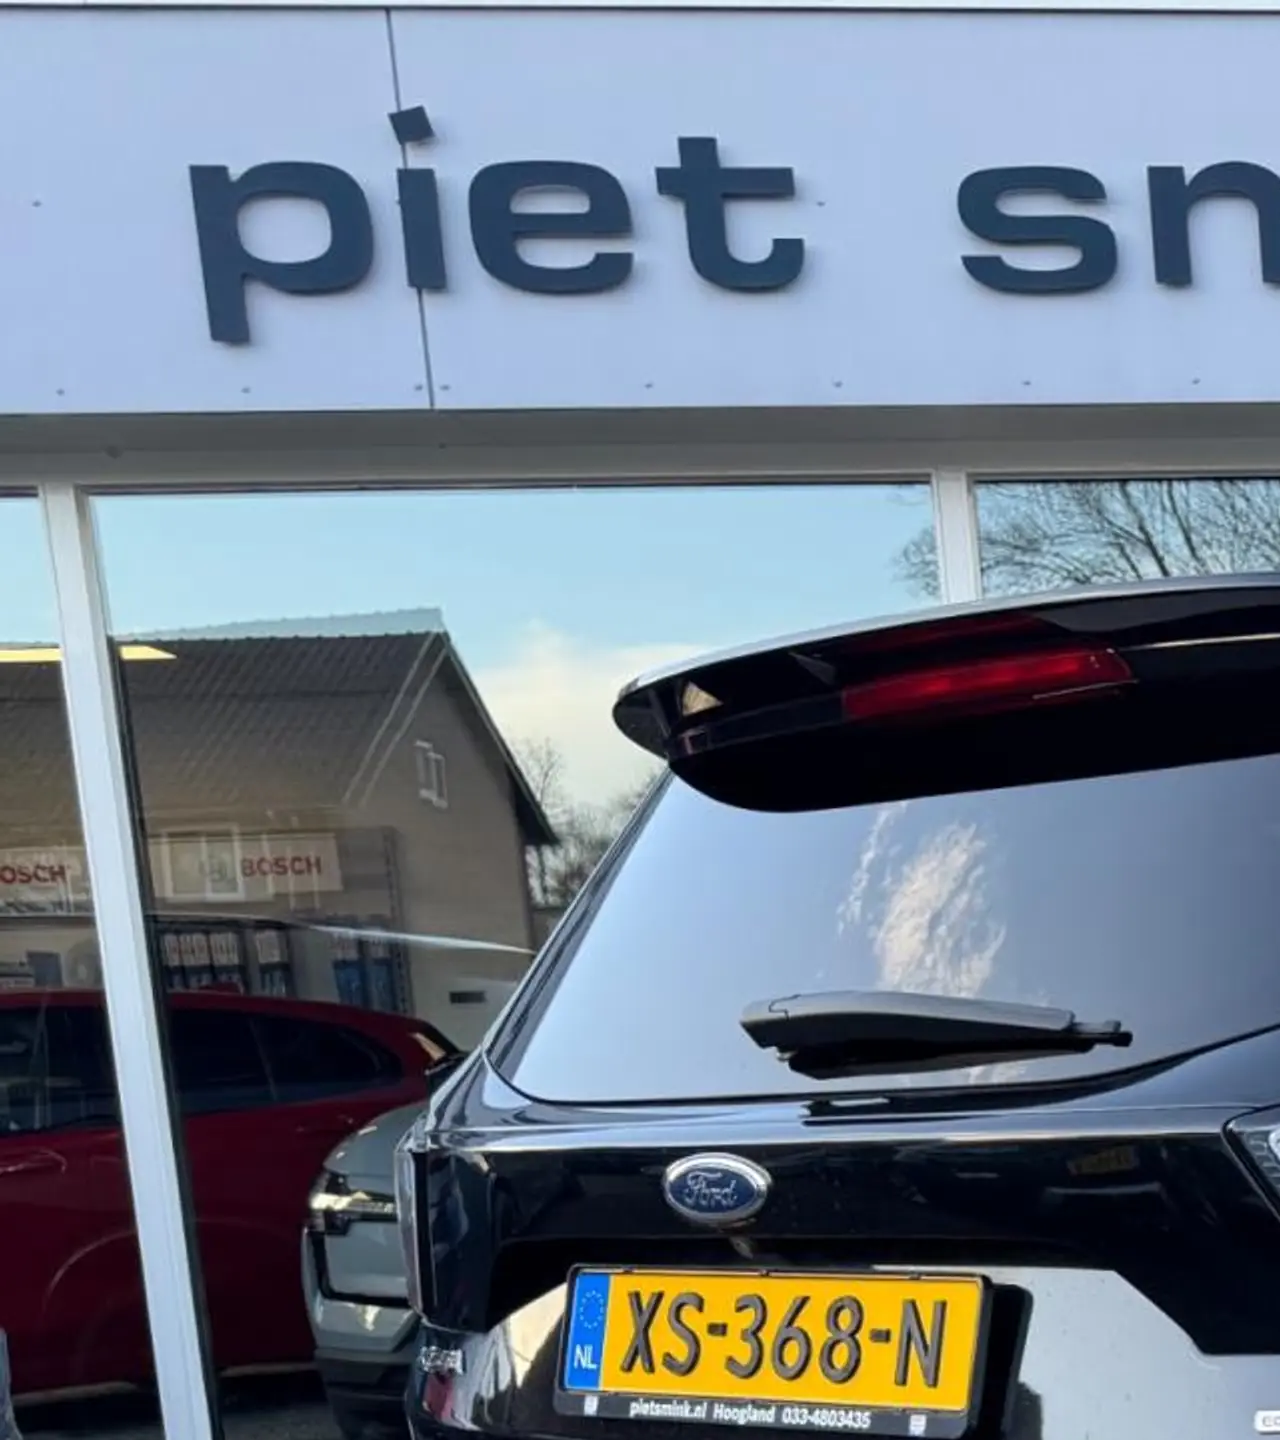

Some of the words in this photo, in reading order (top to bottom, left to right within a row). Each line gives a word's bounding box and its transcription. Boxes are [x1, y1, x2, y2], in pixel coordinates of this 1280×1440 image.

[190, 106, 805, 344] piet
[241, 856, 322, 878] BOSCH
[620, 1290, 947, 1387] XS-368-N
[573, 1343, 597, 1371] NL
[629, 1398, 707, 1418] pietsmink.nl
[713, 1403, 776, 1425] Hoogland
[782, 1407, 871, 1429] 033-4803435
